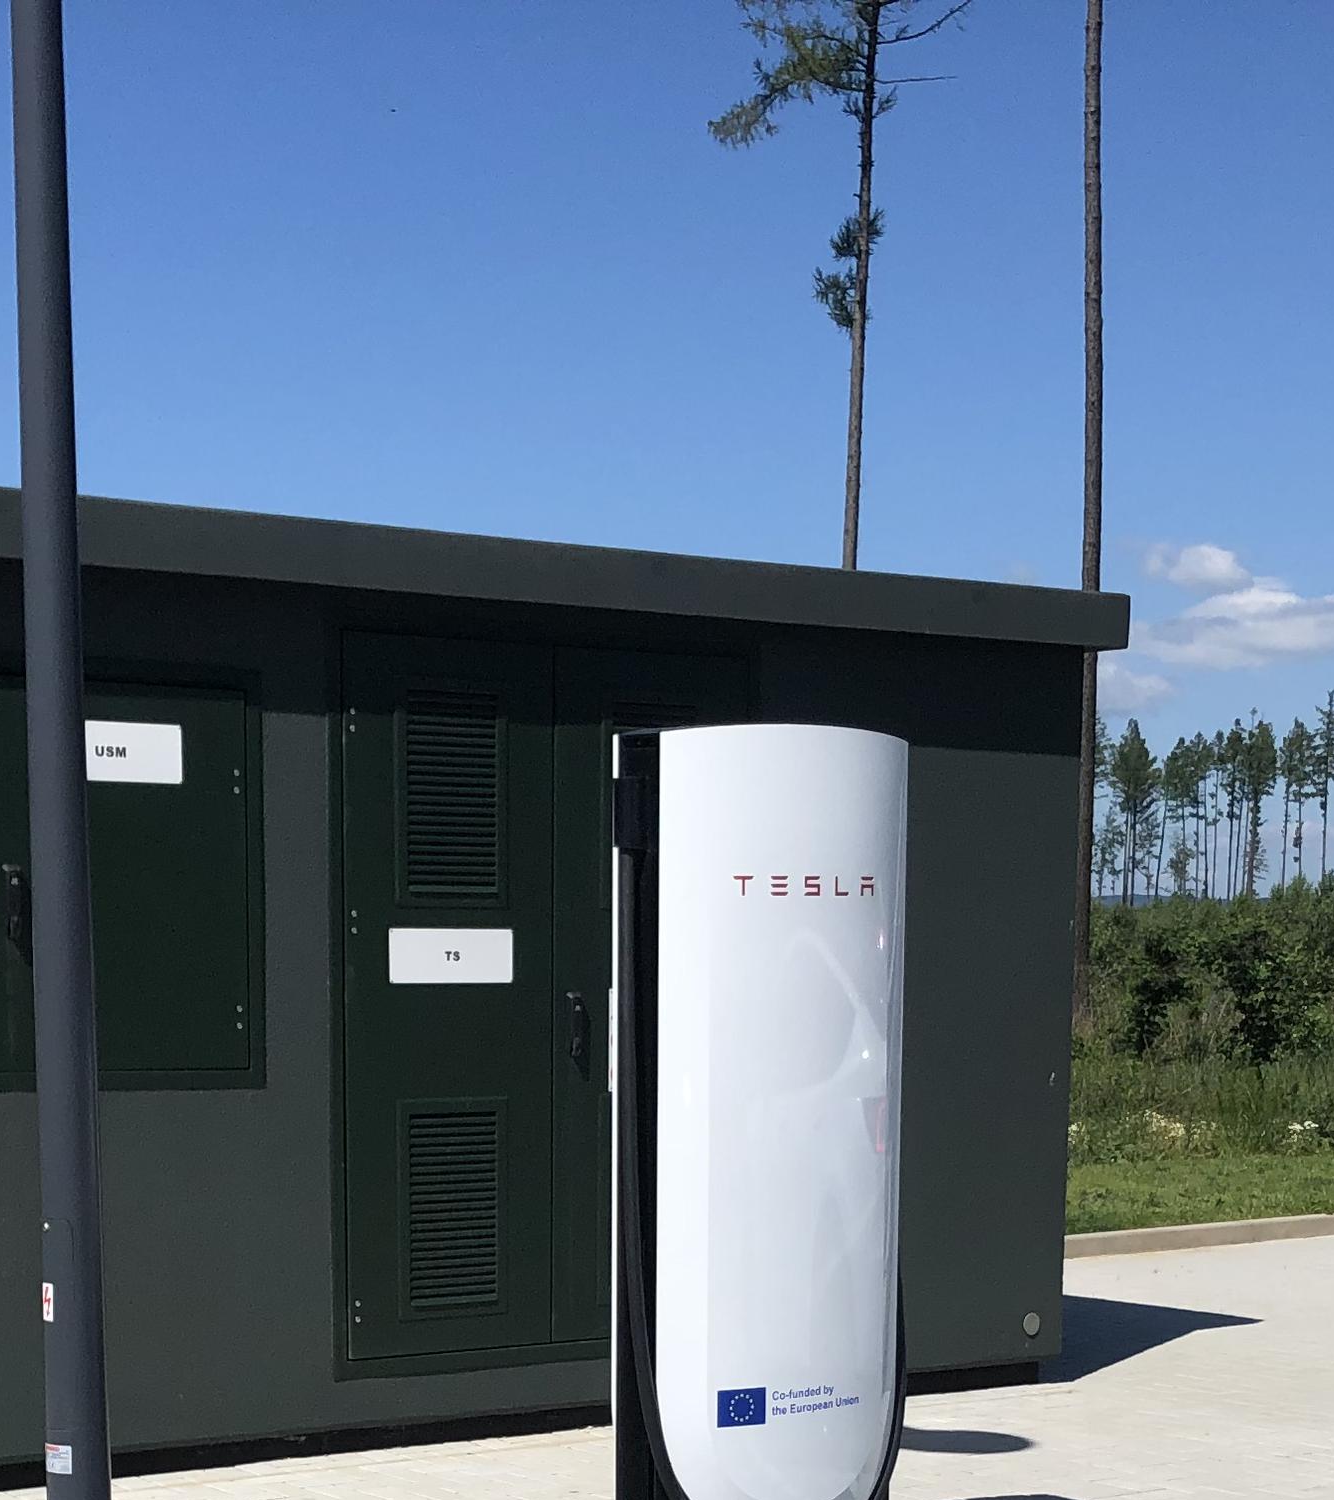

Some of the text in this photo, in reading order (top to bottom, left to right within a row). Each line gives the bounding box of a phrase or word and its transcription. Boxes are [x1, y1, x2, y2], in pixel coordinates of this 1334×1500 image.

[95, 745, 127, 759] USM
[733, 875, 875, 897] TESLA
[444, 950, 461, 962] TS
[771, 1384, 835, 1401] Co-funded by
[771, 1396, 860, 1416] the European Union
